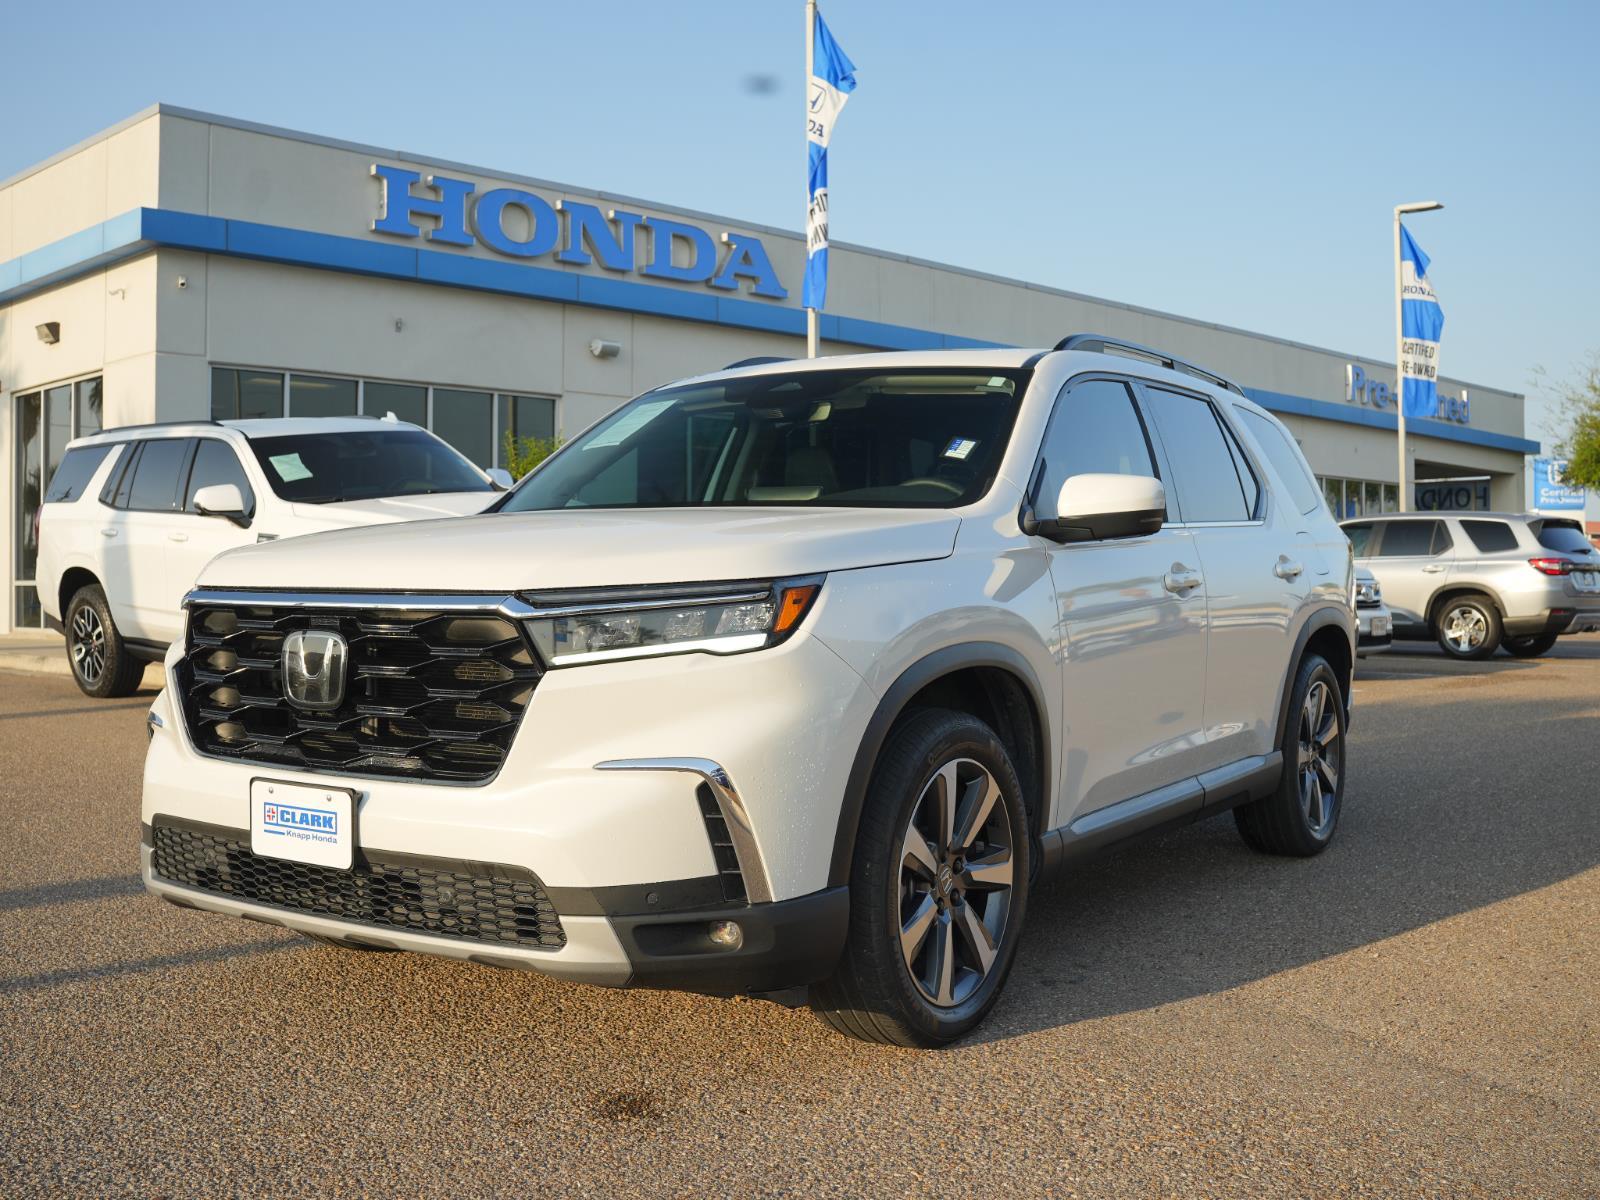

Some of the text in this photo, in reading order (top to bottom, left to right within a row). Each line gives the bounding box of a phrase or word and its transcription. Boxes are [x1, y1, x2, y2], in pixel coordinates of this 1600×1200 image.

[370, 163, 788, 299] HONDA
[1345, 364, 1471, 424] Pre-ned
[280, 808, 334, 830] CLARK
[286, 829, 338, 845] Knapp Honda
